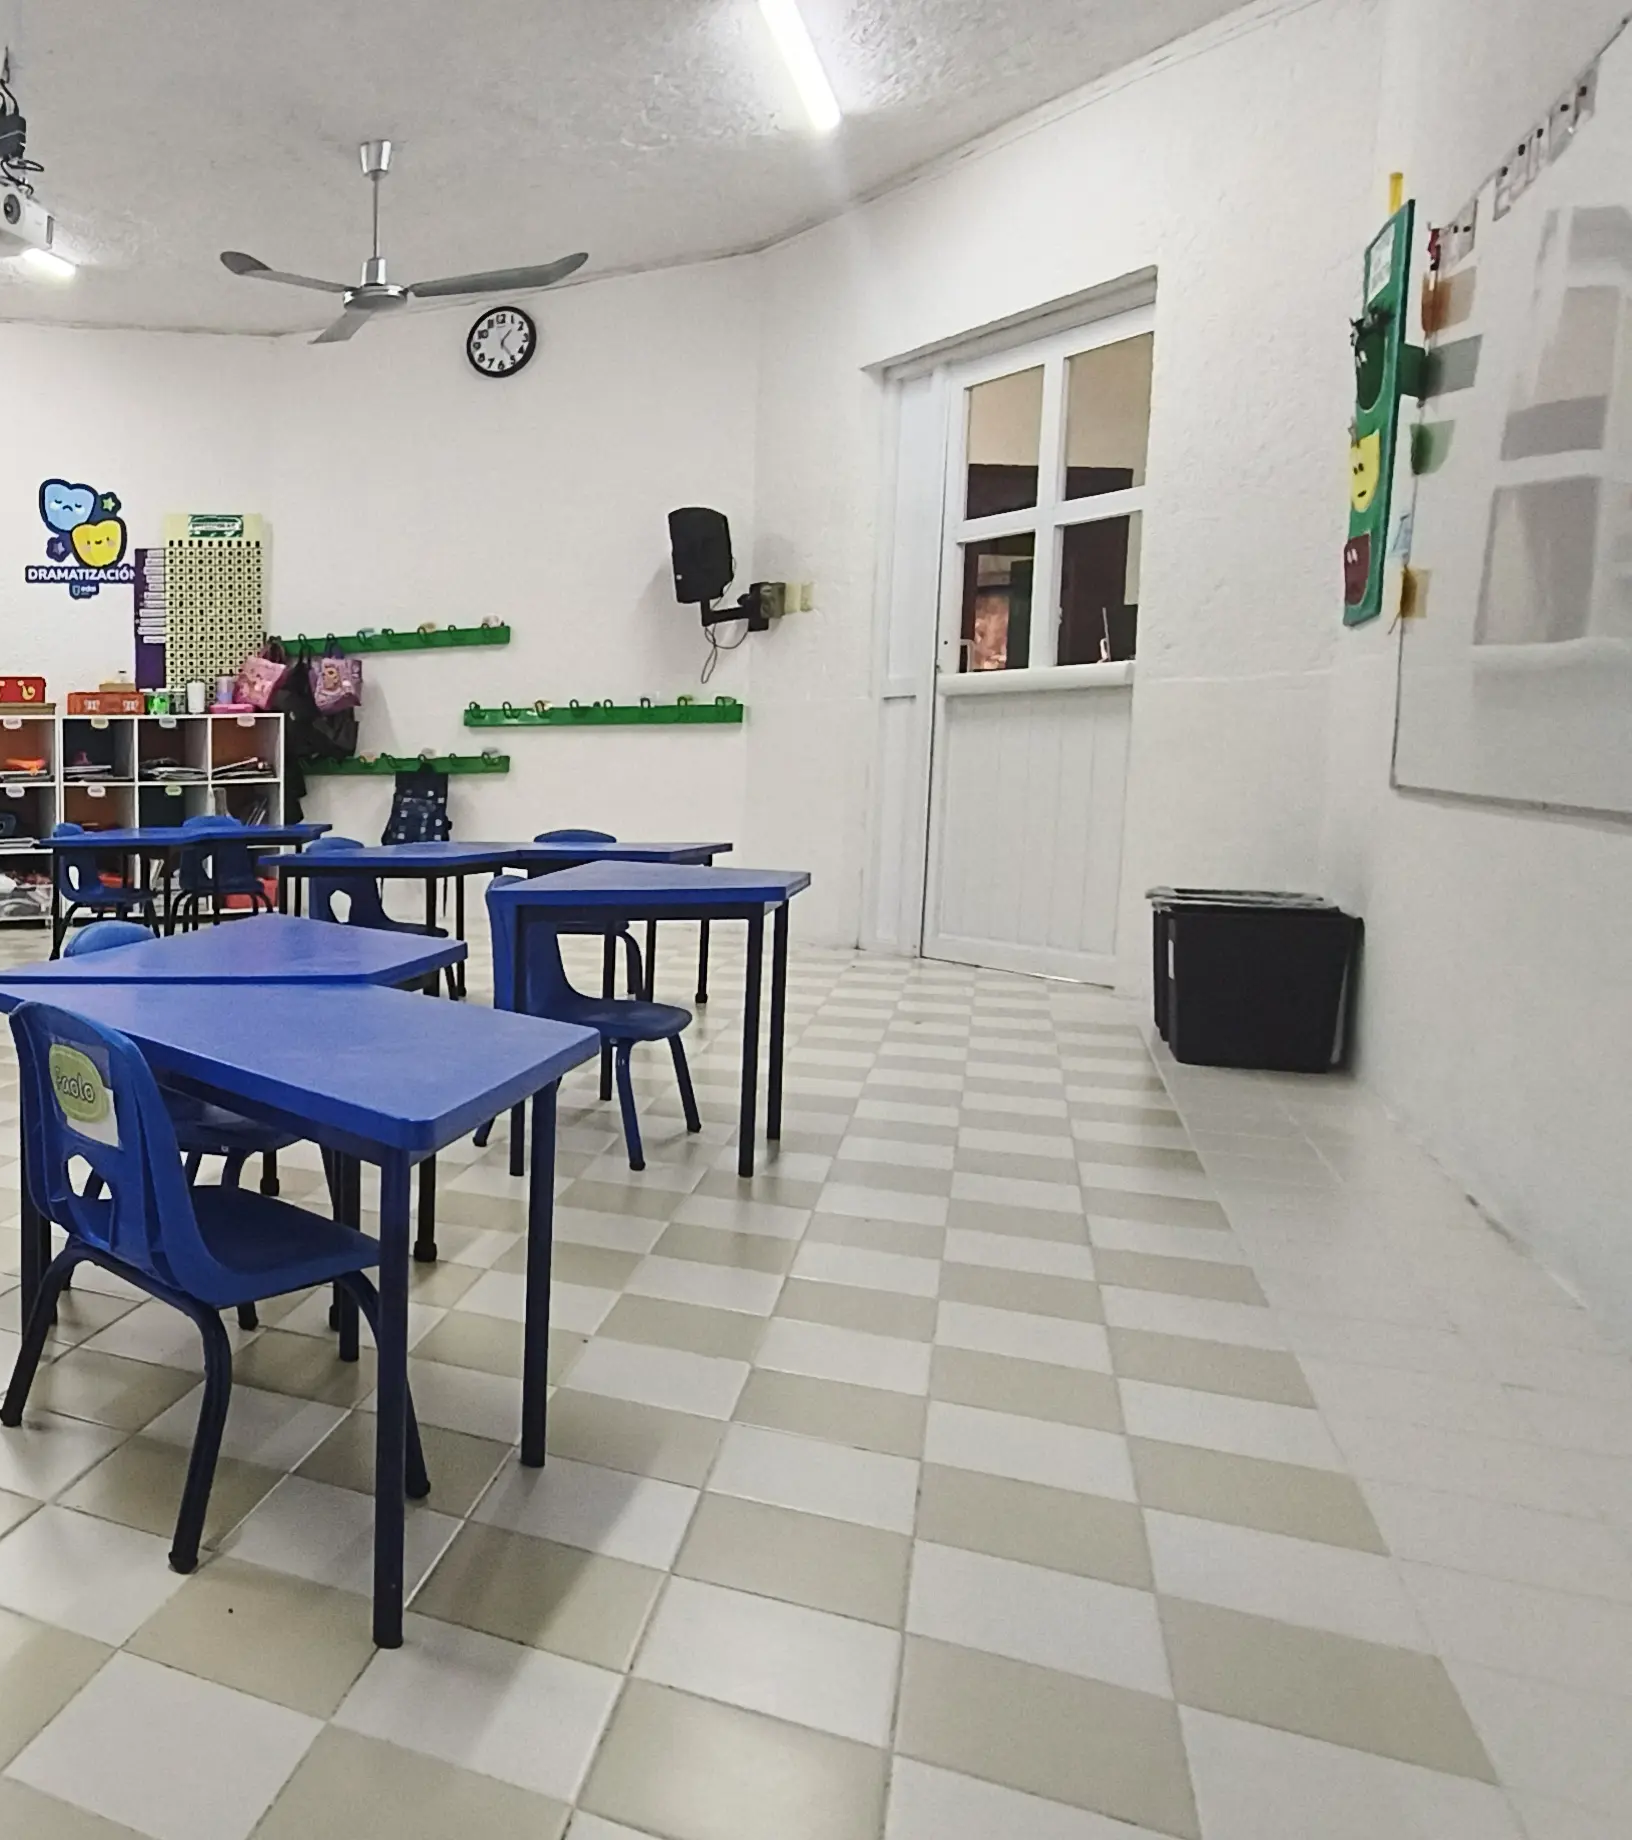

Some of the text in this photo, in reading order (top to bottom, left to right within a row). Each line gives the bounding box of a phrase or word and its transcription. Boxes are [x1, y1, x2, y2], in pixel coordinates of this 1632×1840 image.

[511, 315, 514, 324] 1
[518, 321, 524, 331] 2
[488, 358, 495, 368] 7
[498, 360, 505, 370] 6
